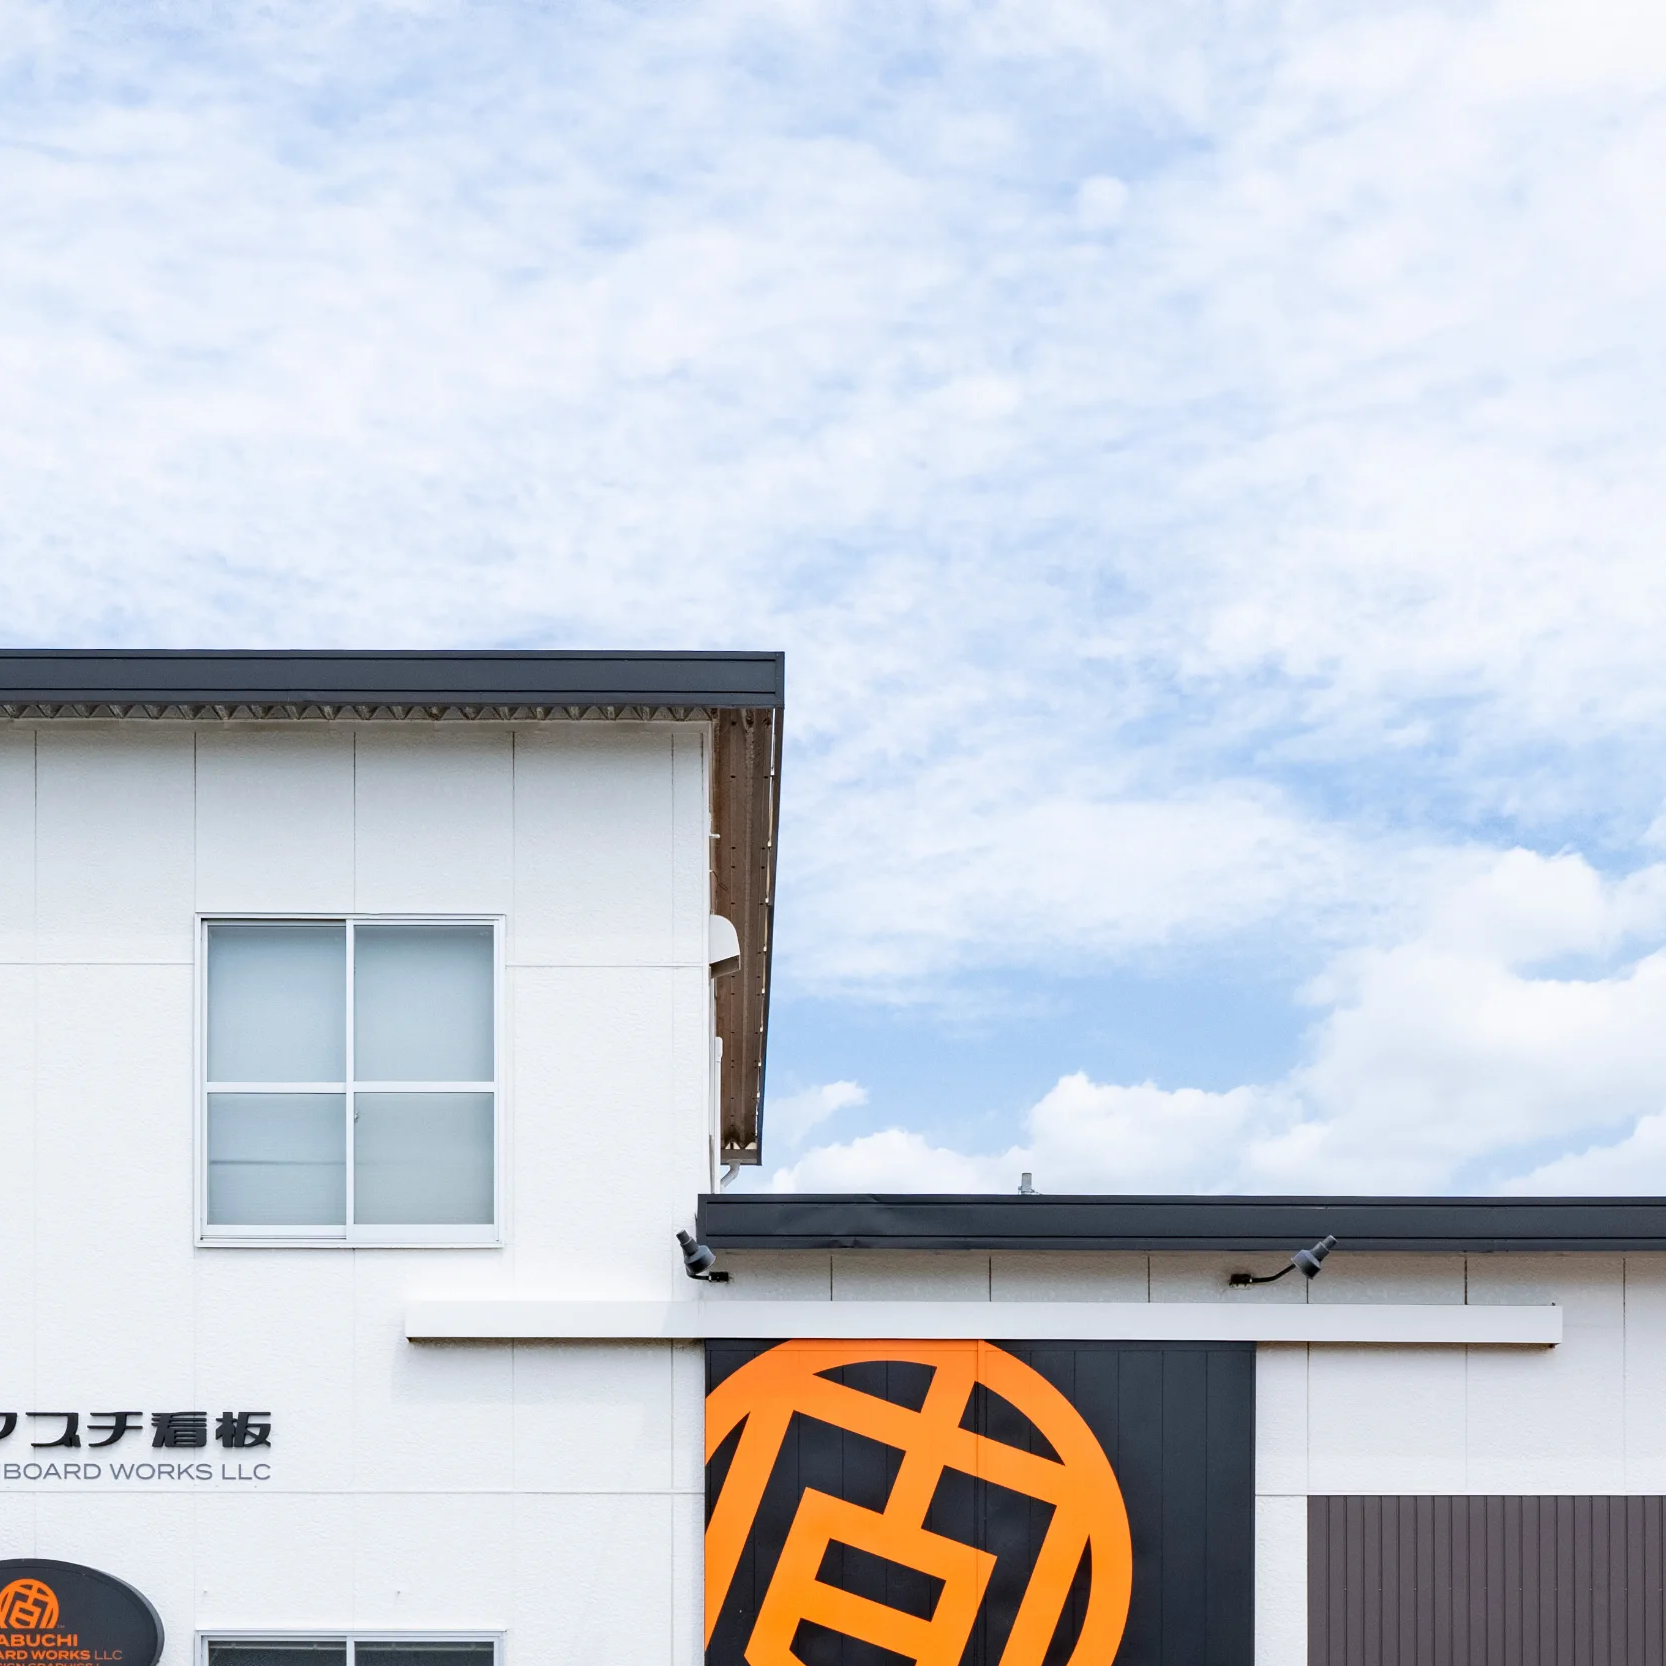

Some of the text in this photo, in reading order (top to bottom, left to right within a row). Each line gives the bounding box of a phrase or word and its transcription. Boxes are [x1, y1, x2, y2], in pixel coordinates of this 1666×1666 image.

[110, 1462, 213, 1480] WORKS
[222, 1463, 271, 1480] LLC
[32, 1650, 91, 1661] WORKS
[94, 1650, 123, 1661] LLC
